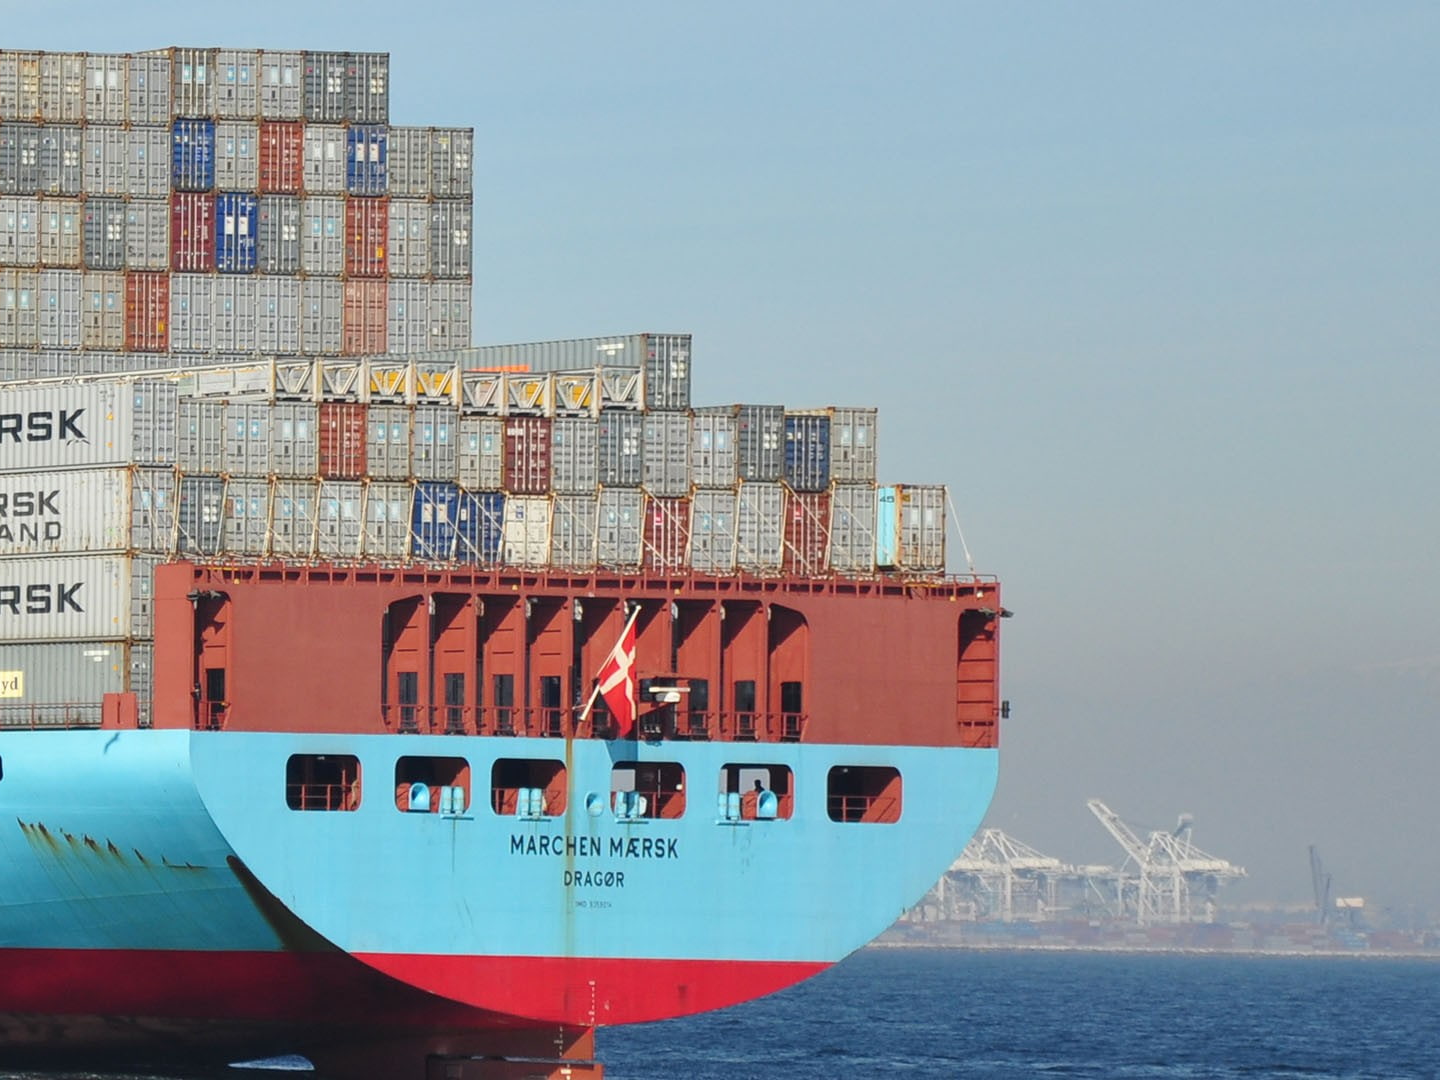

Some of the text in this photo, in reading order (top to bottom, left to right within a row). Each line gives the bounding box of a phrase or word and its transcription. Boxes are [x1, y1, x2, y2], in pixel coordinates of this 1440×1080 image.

[511, 835, 679, 858] MARCHEN MÆRSK
[564, 871, 625, 888] DRAGØR
